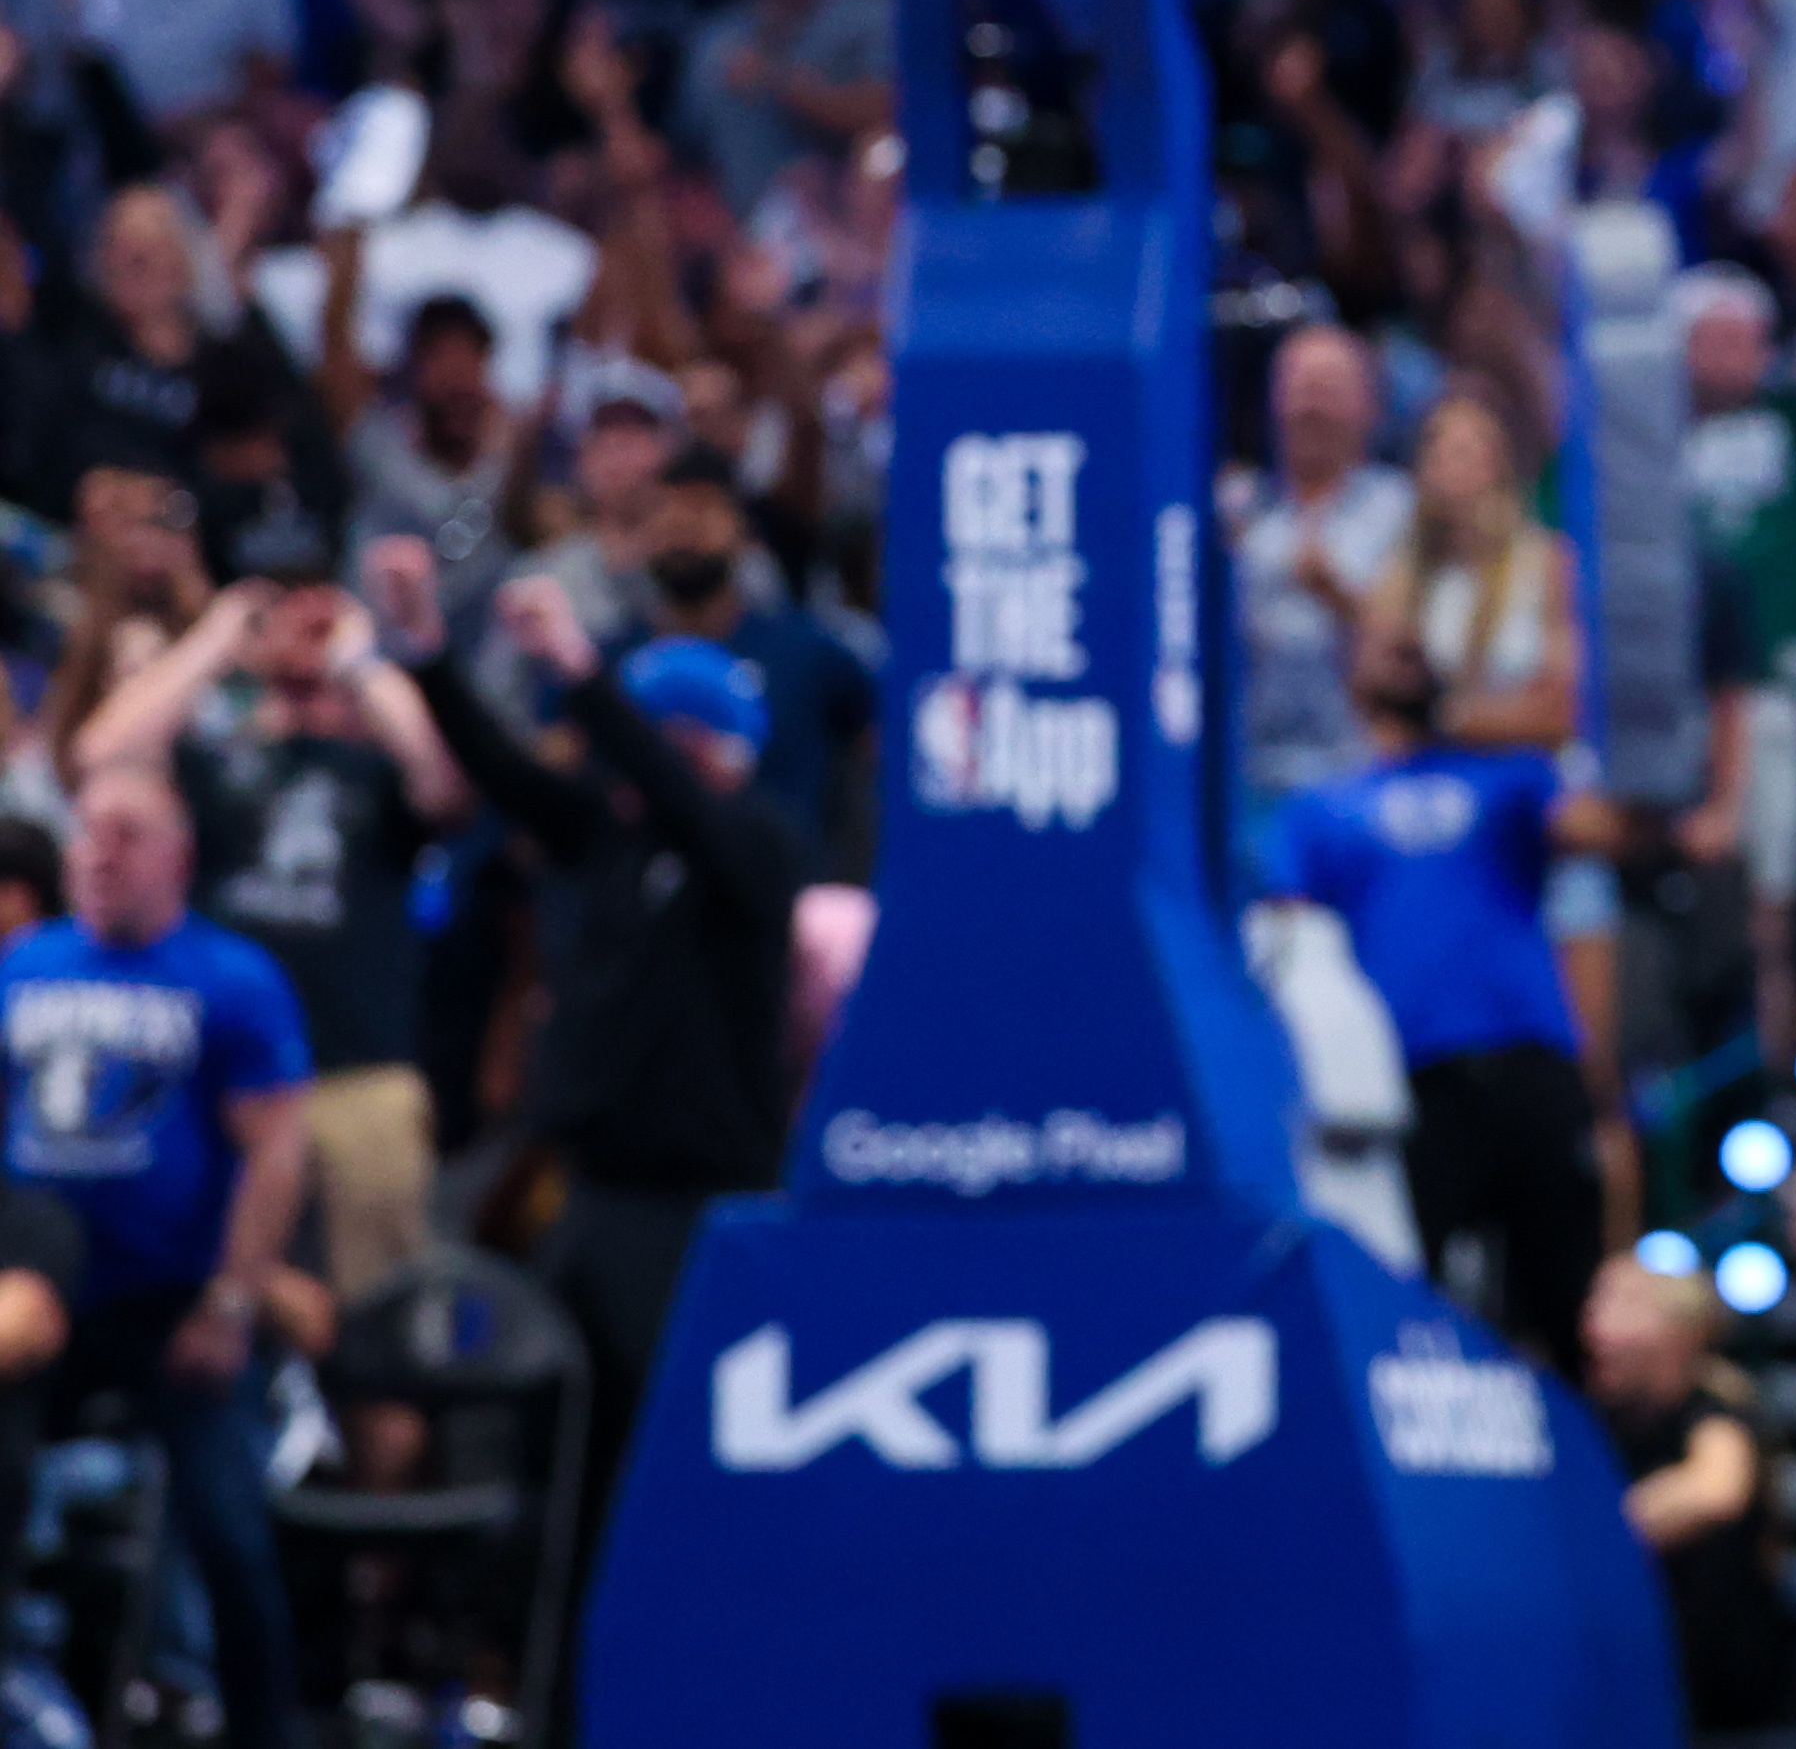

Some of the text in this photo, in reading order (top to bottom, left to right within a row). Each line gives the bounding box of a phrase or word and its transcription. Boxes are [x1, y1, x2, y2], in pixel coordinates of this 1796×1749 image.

[942, 433, 1084, 552] GET
[944, 553, 1086, 680] THE
[826, 1110, 1184, 1194] Google Pixel
[714, 1318, 1278, 1470] KIA
